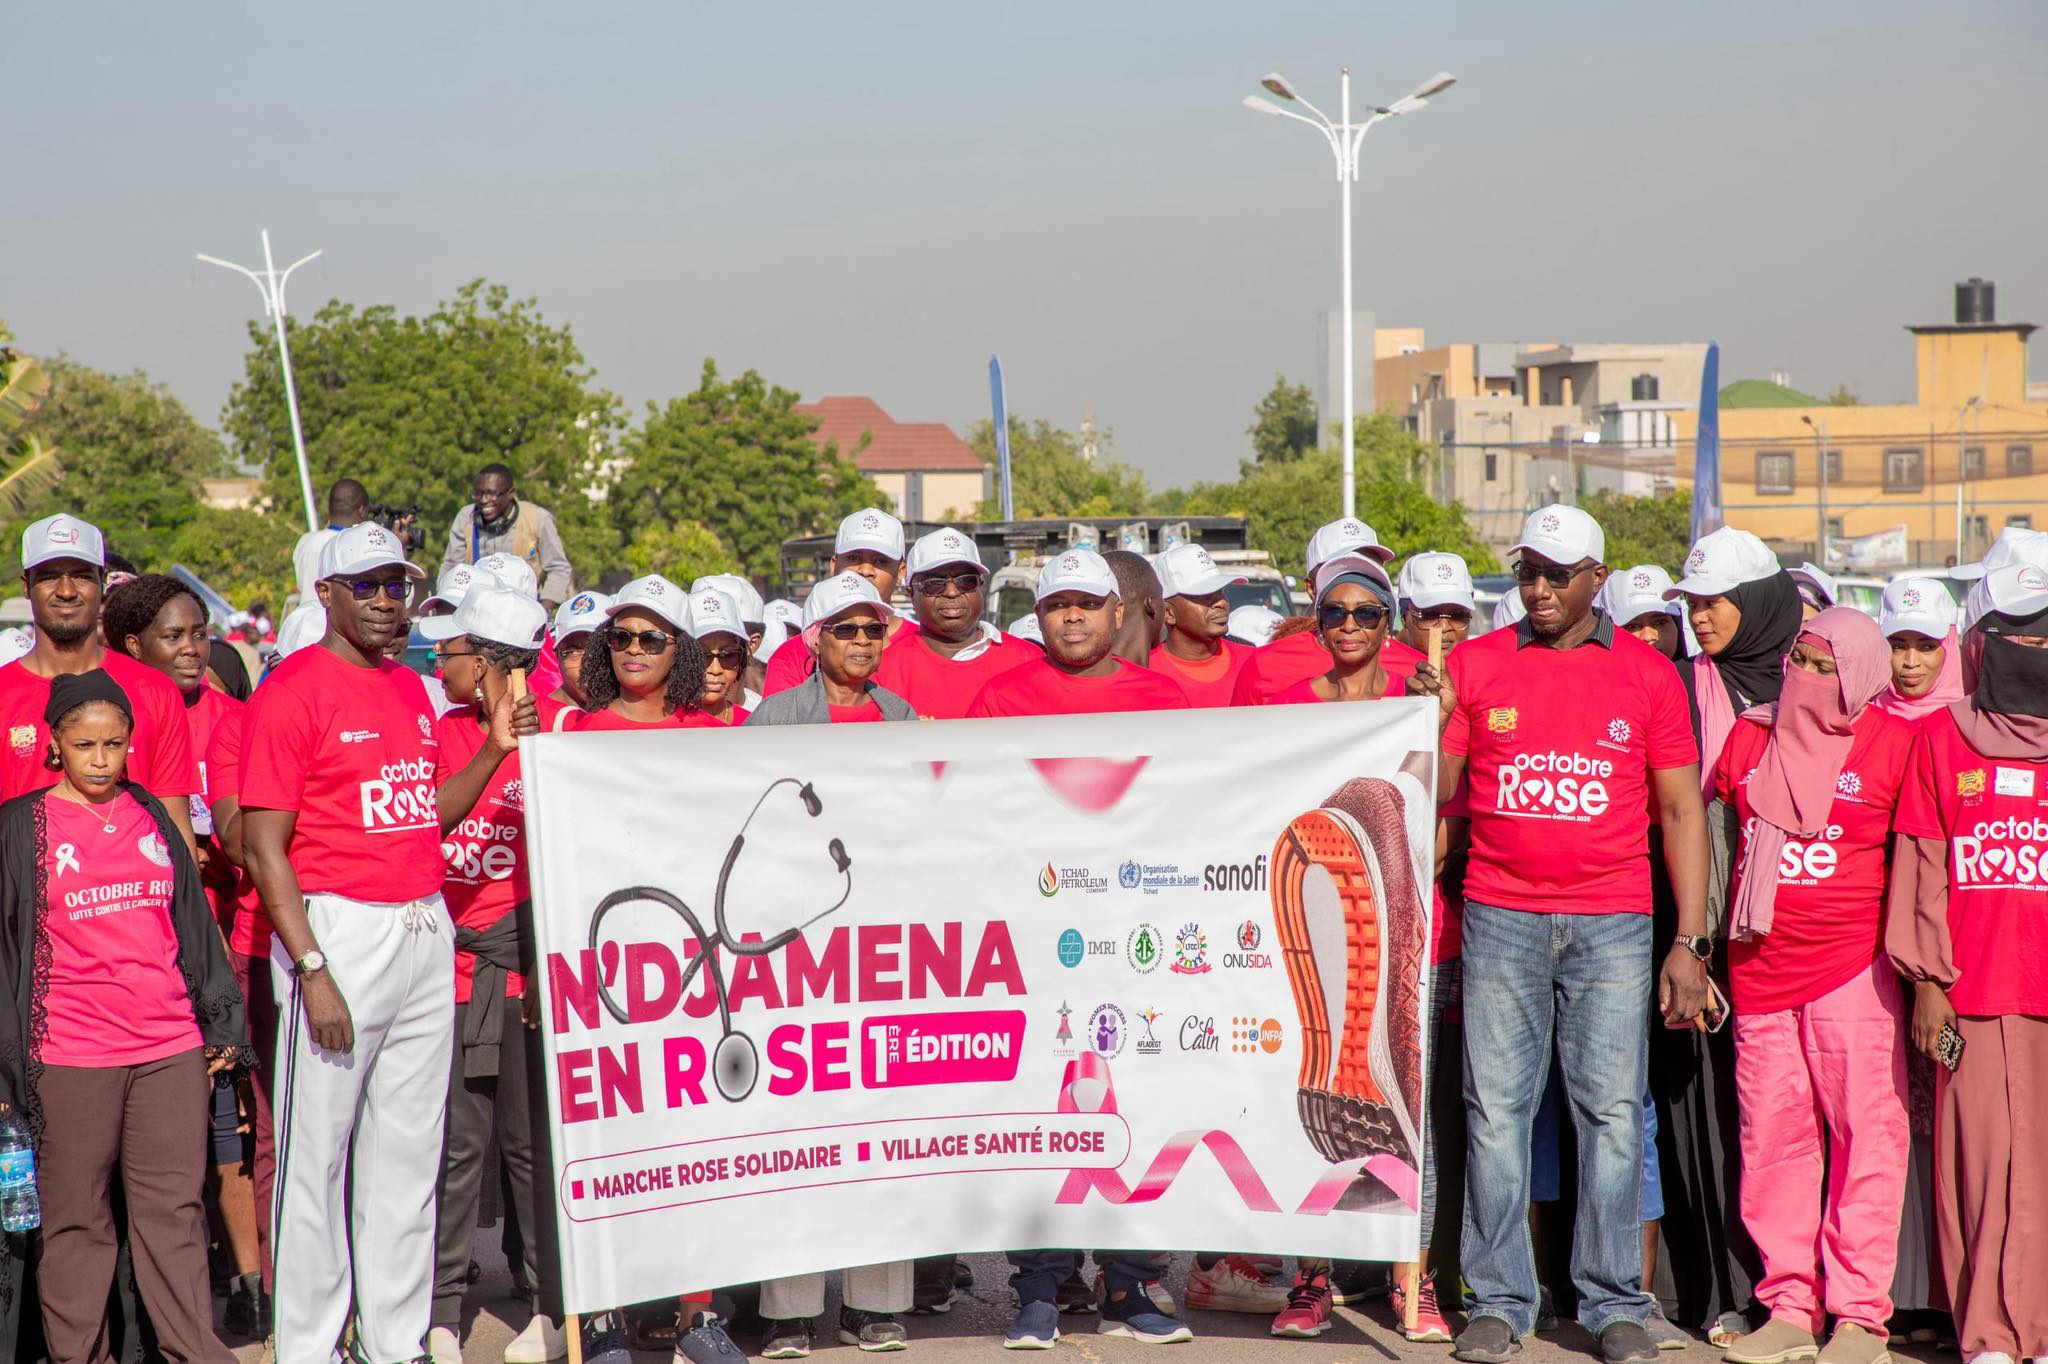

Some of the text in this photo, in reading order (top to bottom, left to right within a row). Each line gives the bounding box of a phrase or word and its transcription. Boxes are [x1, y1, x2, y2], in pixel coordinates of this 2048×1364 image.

[381, 756, 436, 783] octob
[1514, 750, 1613, 778] octobre
[1497, 765, 1609, 816] Rose
[1974, 816, 2048, 841] octob
[441, 839, 516, 880] ose
[1143, 864, 1178, 876] Organisation
[1061, 868, 1089, 878] TCHAD
[1061, 878, 1108, 889] PETROLEUM
[1143, 874, 1199, 884] mondiale de la Santé
[1203, 855, 1266, 891] sanofi
[64, 881, 144, 908] OCTOBRE
[69, 908, 94, 921] LUTTE
[95, 903, 122, 916] CONTRE
[123, 900, 131, 910] LE
[131, 898, 162, 909] CANCER
[1088, 941, 1116, 955] IMRI
[1223, 953, 1272, 968] ONUSIDA
[1089, 1003, 1127, 1026] WOMEN SUCCESS
[906, 1028, 1010, 1063] ÉDITION
[1136, 1040, 1162, 1048] AFLADEGT
[557, 1042, 644, 1124] EN
[882, 1126, 1105, 1161] VILLAGE SANTÉ ROSE
[593, 1144, 841, 1200] MARCHE ROSE SOLIDAIRE
